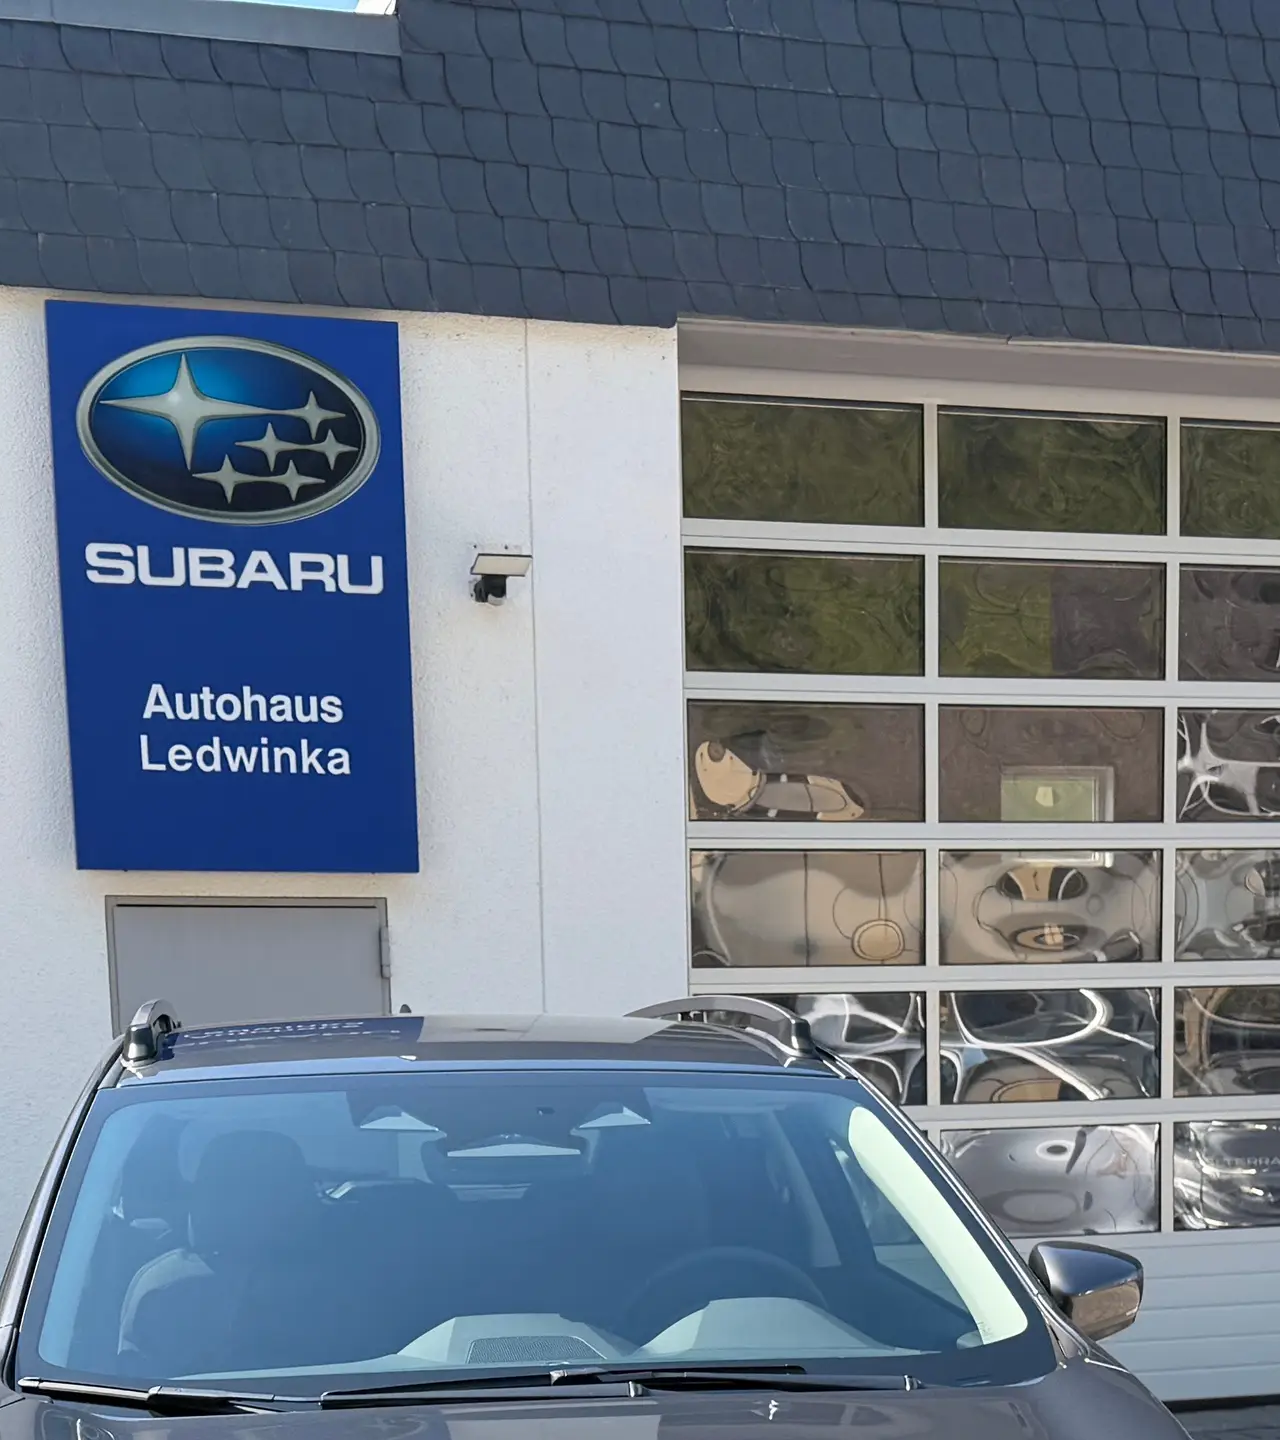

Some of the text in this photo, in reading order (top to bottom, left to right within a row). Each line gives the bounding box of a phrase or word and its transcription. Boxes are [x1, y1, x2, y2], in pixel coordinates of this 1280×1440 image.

[85, 542, 384, 595] SUBARU
[142, 683, 343, 723] Autohaus
[140, 734, 351, 775] Ledwinka
